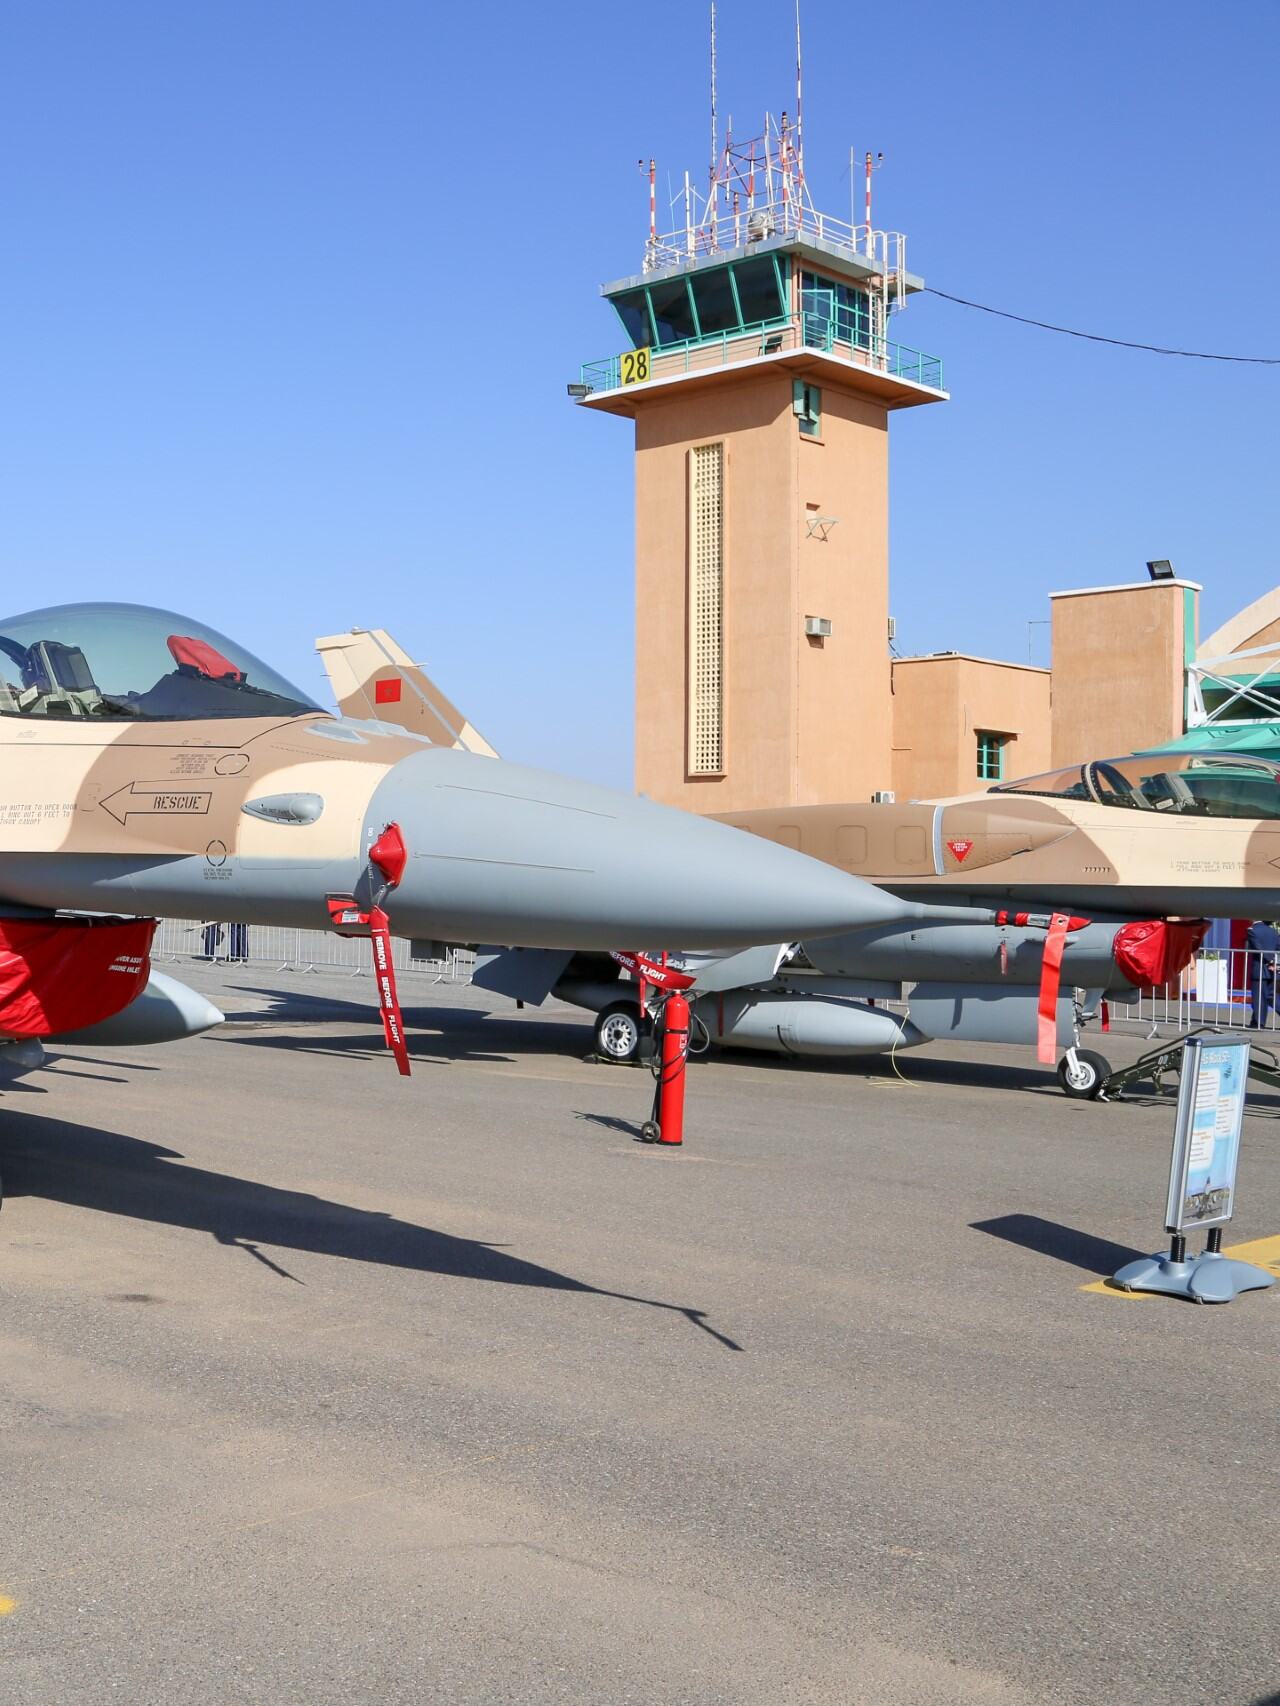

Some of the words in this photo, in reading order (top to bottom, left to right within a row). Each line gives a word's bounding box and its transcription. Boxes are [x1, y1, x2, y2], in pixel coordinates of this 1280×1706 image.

[624, 351, 647, 384] 28
[153, 796, 202, 809] RESCUE
[375, 936, 387, 970] REMOVE
[640, 964, 667, 982] FLIGHT
[381, 977, 393, 1009] BEFORE
[388, 1014, 401, 1044] FLIGHT
